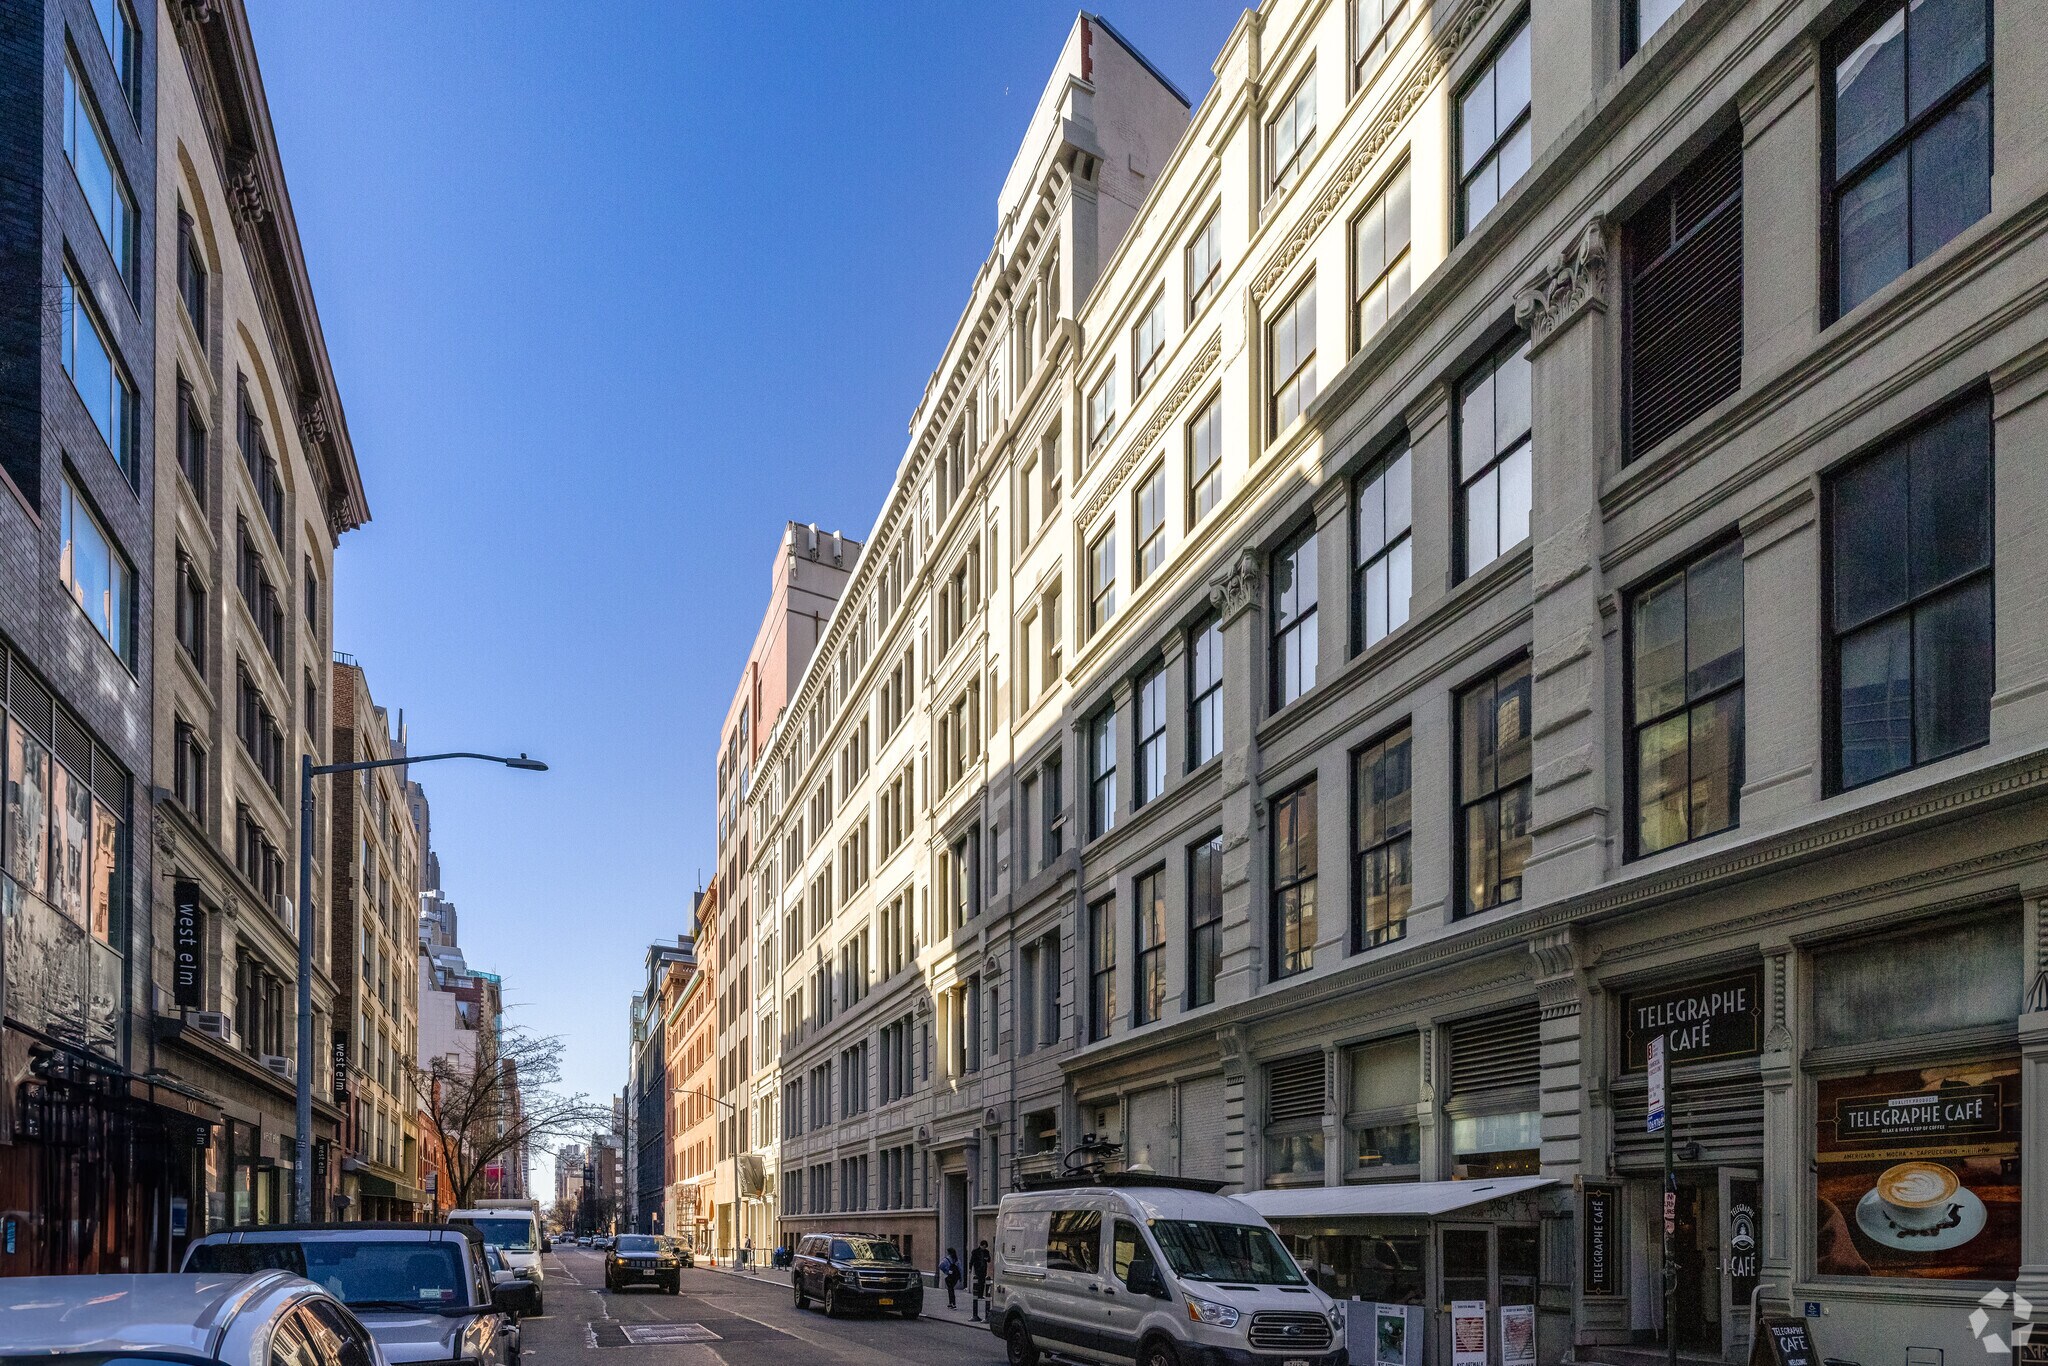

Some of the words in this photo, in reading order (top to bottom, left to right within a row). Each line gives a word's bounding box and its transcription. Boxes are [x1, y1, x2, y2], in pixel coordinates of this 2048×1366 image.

[180, 904, 197, 946] west
[180, 953, 196, 986] elm
[1638, 988, 1746, 1029] TELEGRAPHE
[1670, 1019, 1711, 1052] CAFÉ
[336, 1043, 346, 1068] west
[336, 1071, 346, 1091] elm
[1849, 1105, 1940, 1128] TELEGRAPHE
[1945, 1098, 1983, 1121] CAFÉ
[196, 1127, 207, 1145] elm
[1592, 1200, 1604, 1223] CAFÉ
[1730, 1204, 1755, 1218] TELEGRAPHE
[1594, 1226, 1604, 1284] TELEGRAPHE
[1732, 1252, 1756, 1277] CAFÉ
[1772, 1326, 1804, 1336] TELEGRAPHE
